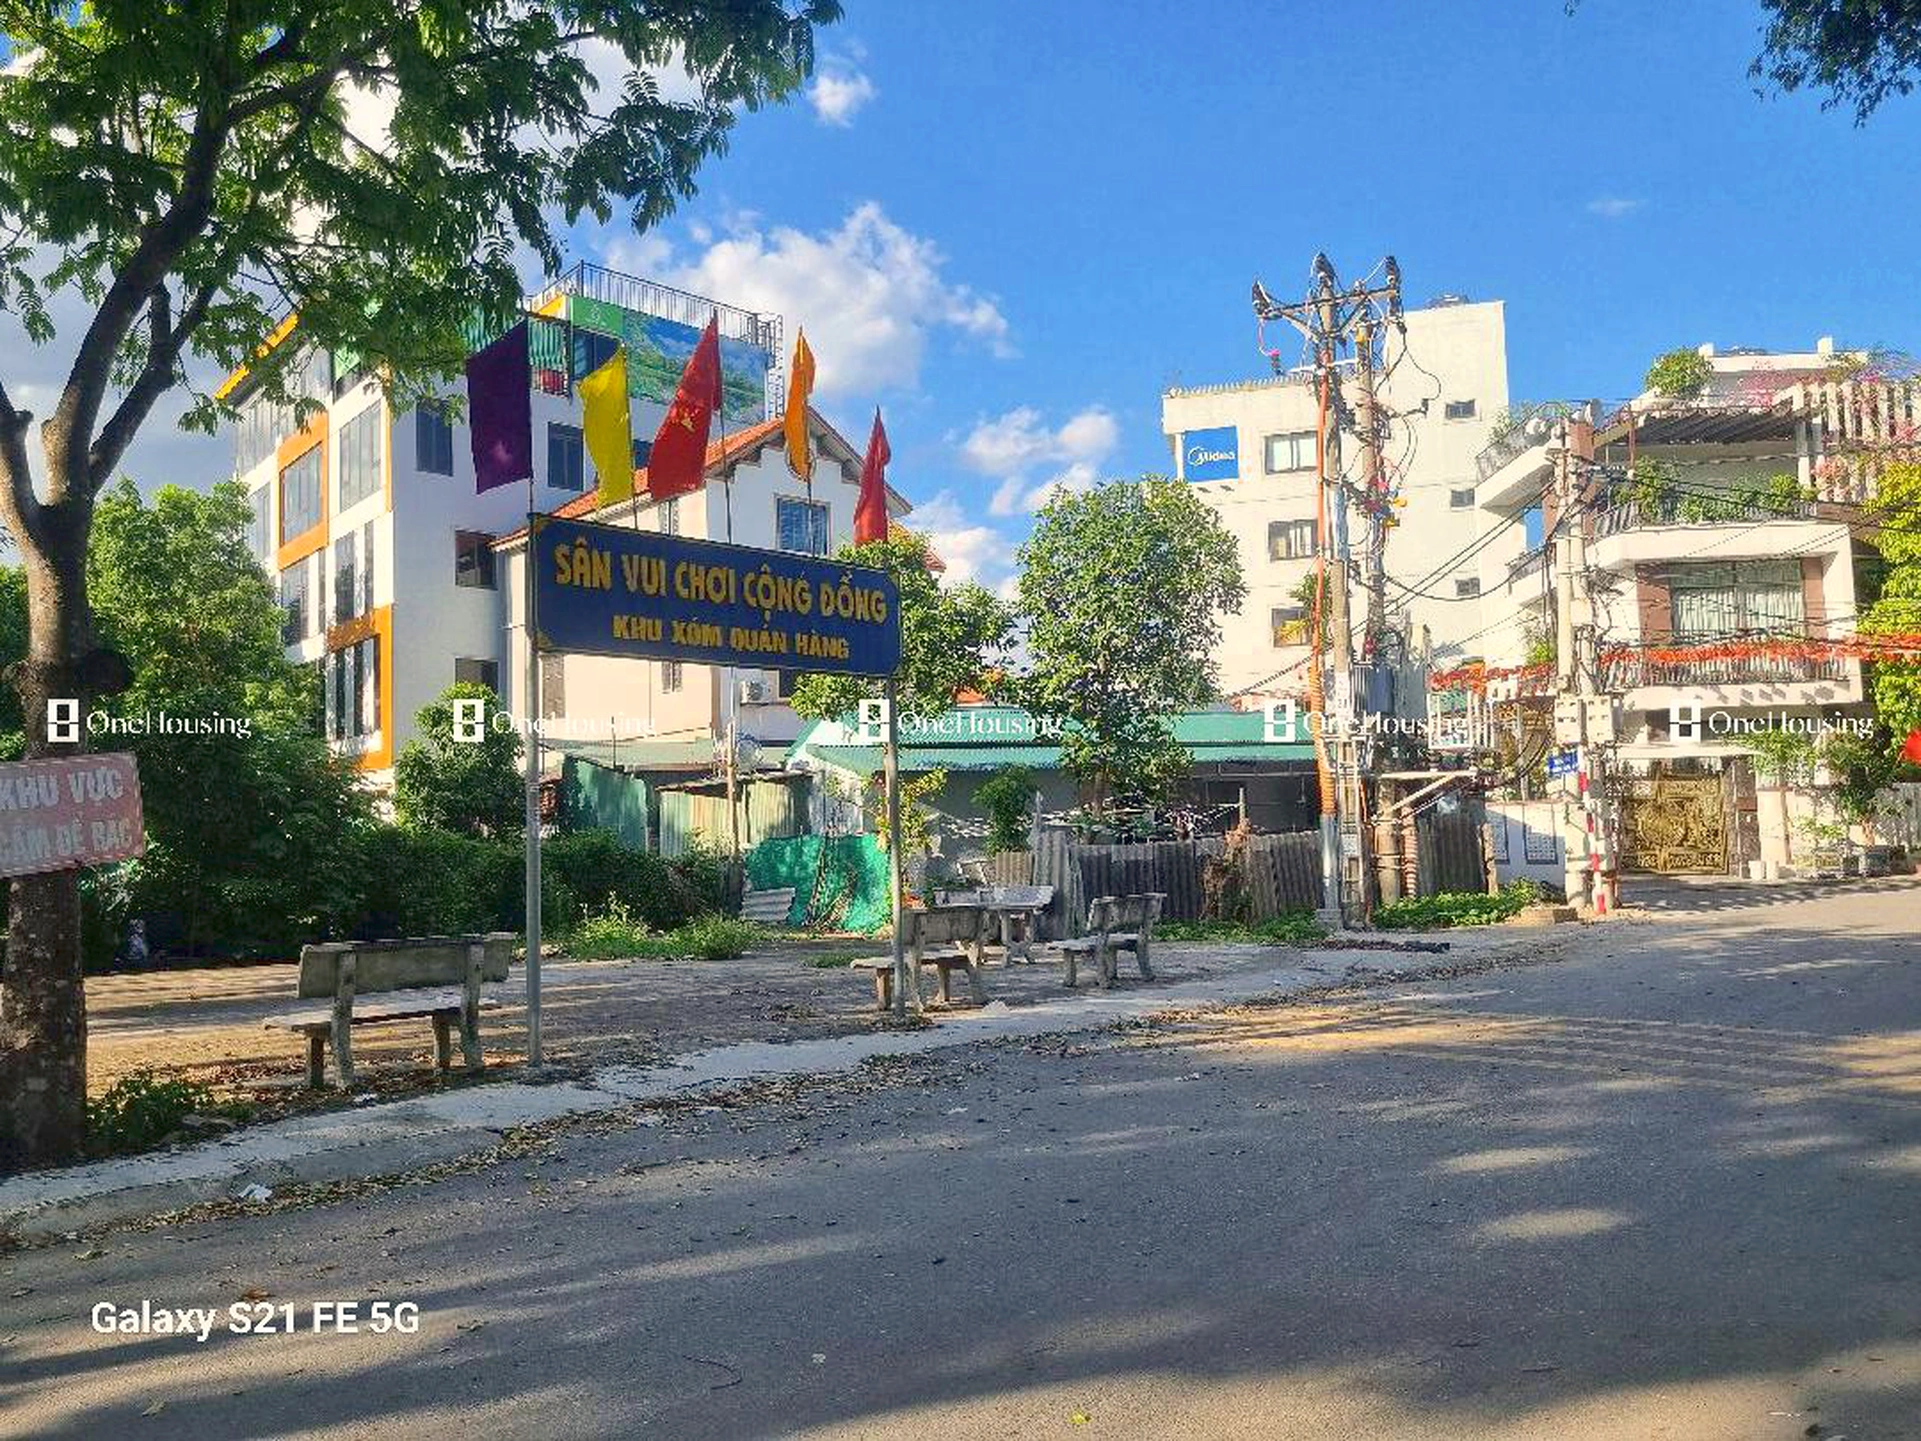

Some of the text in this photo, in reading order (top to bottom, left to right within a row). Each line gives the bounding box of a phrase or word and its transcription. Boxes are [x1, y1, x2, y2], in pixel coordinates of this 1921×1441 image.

[554, 537, 612, 590] SÂN
[621, 554, 667, 596] VUI
[674, 560, 736, 604] CHƠI
[743, 563, 812, 621] CỘNG
[612, 614, 662, 641] KHU
[671, 617, 722, 647] XÓM
[795, 629, 850, 659] HÀNG
